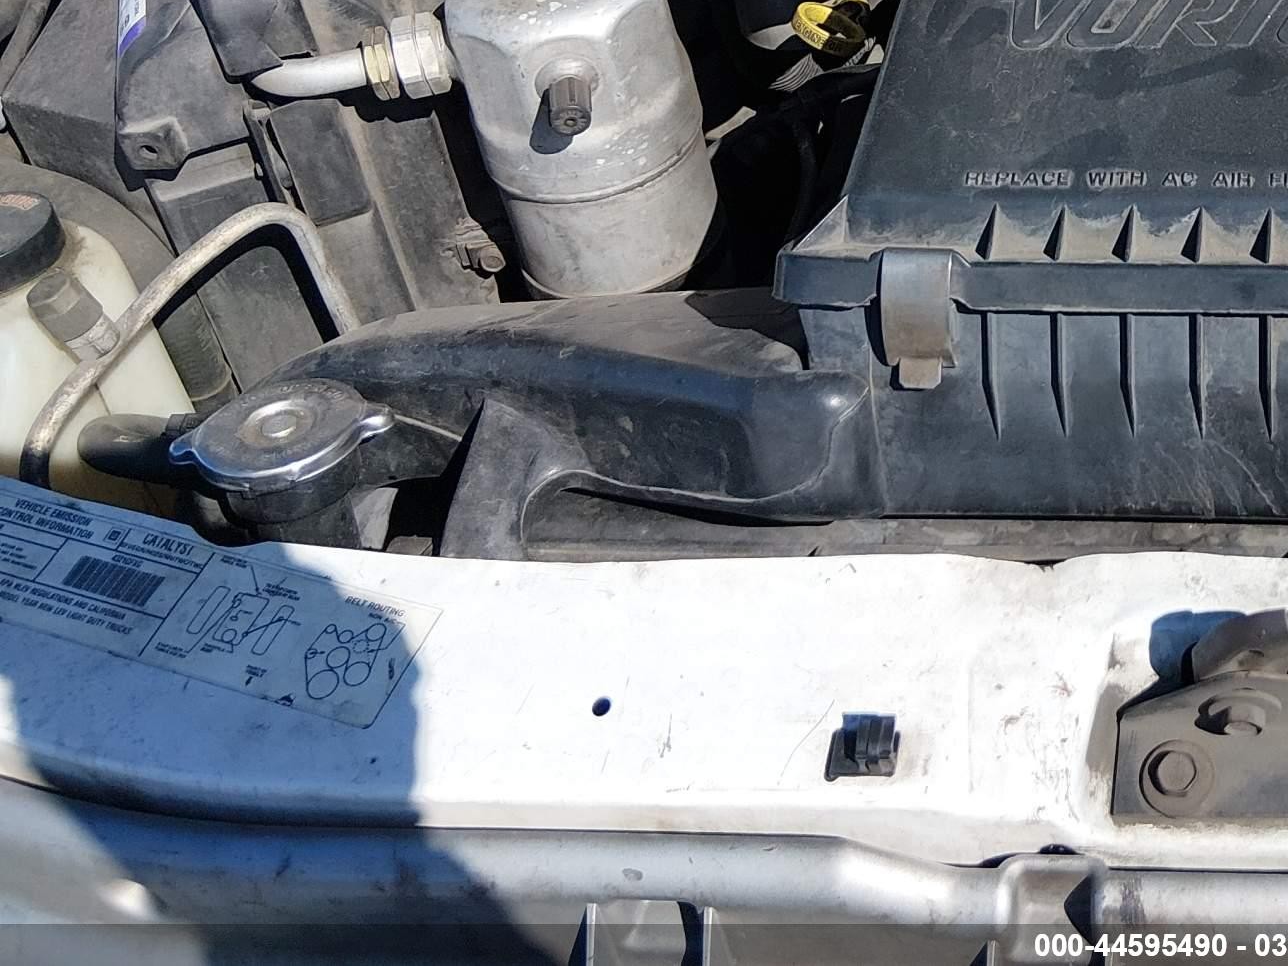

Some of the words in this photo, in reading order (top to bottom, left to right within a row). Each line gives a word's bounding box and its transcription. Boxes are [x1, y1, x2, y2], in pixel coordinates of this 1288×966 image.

[794, 19, 826, 48] ENGINE
[963, 170, 1073, 188] REPLACE
[1087, 170, 1147, 188] WITH
[1212, 170, 1255, 189] AIR
[15, 498, 50, 515] VEHICLE
[49, 508, 93, 527] EMISSION
[35, 516, 94, 540] INFORMATION
[143, 532, 196, 555] CATALYST
[344, 595, 368, 607] BELT
[367, 601, 406, 617] ROUTING
